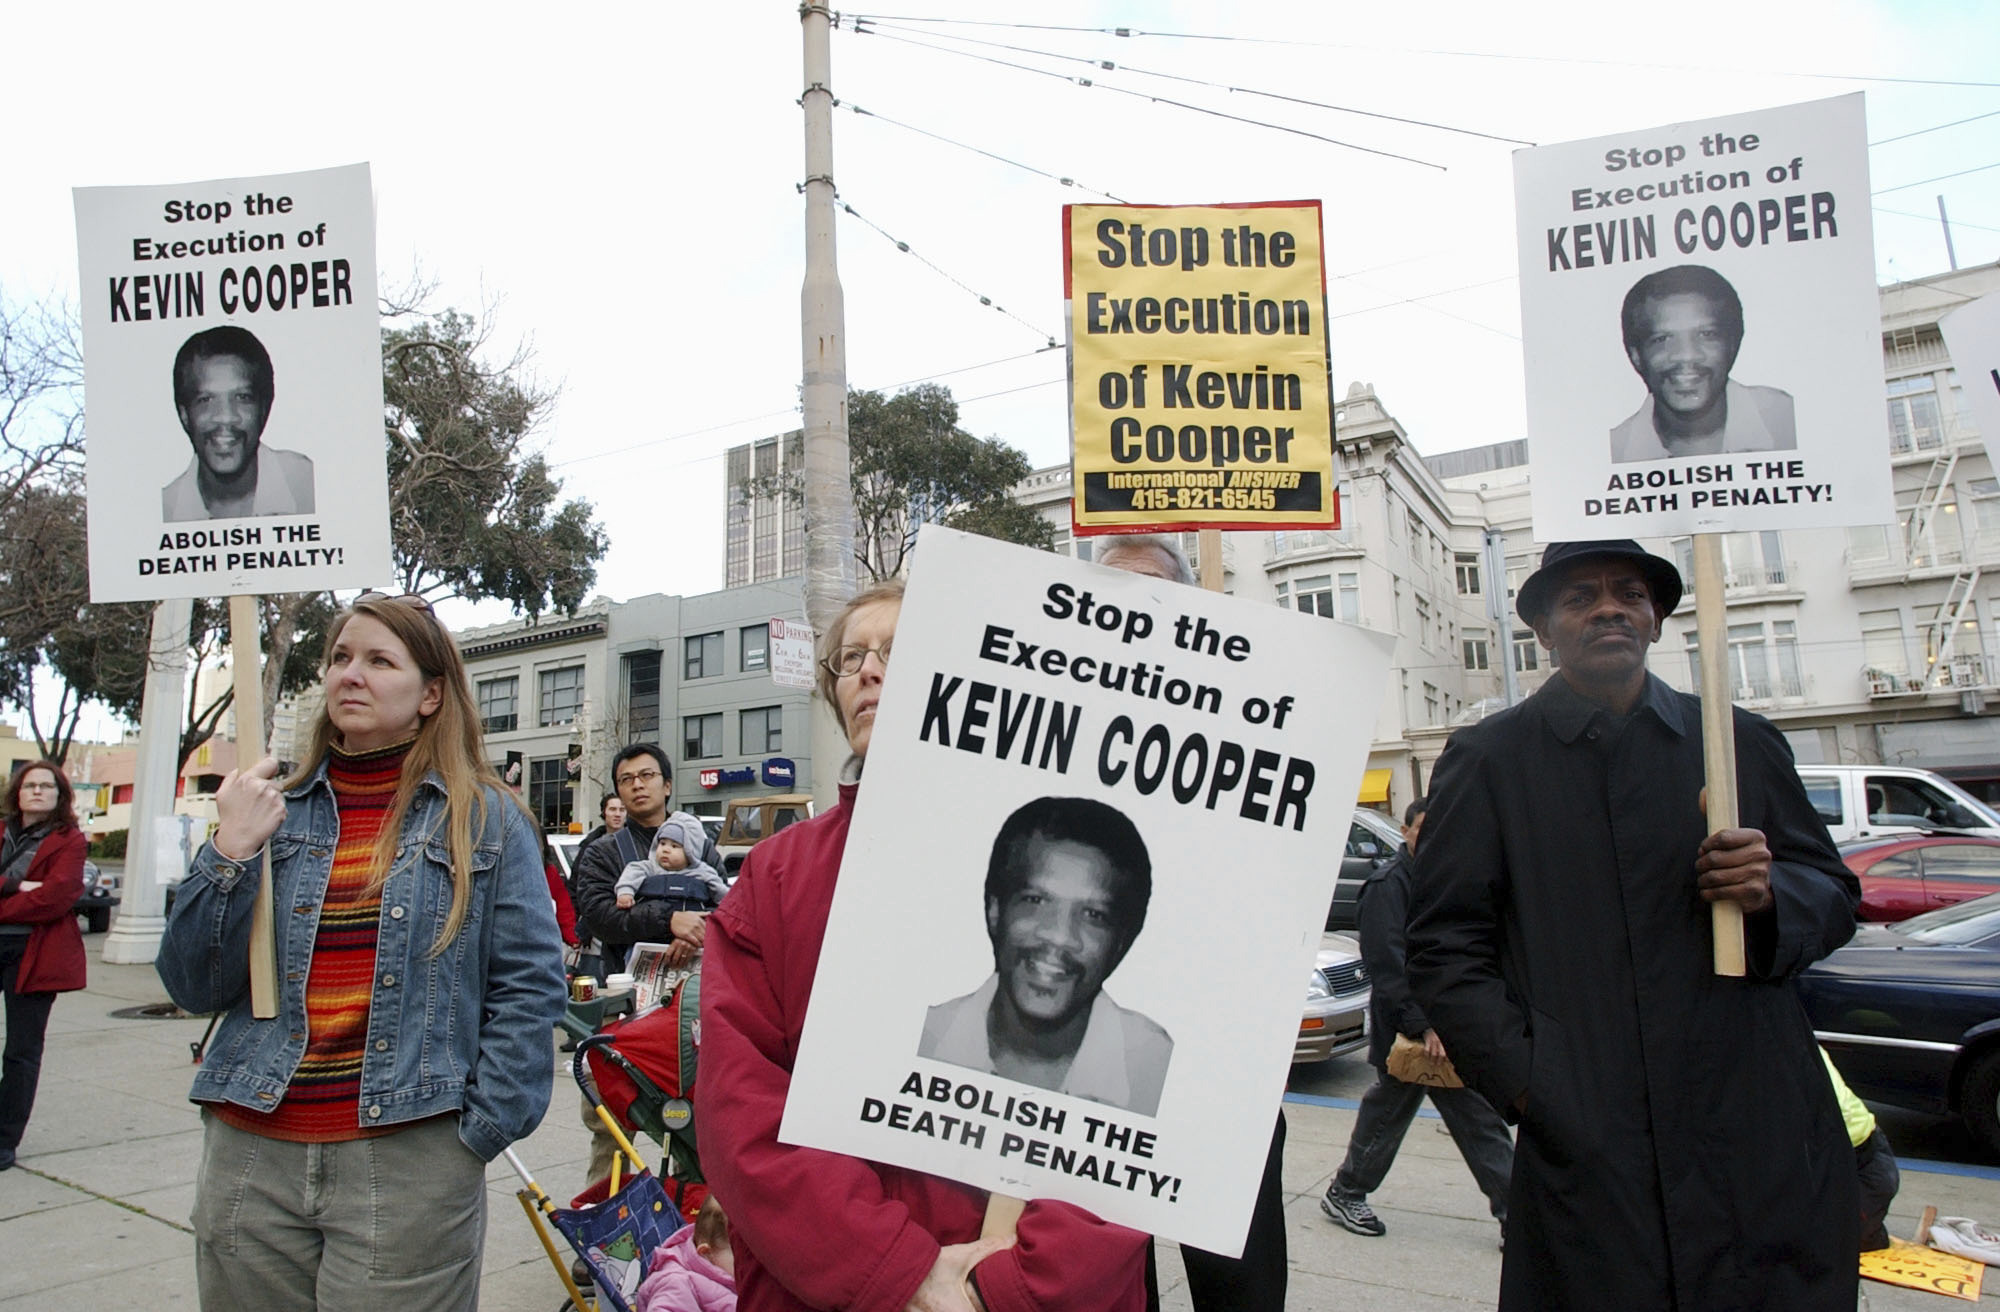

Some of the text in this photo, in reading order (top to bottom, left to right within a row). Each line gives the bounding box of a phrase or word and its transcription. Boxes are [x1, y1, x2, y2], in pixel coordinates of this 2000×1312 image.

[1606, 133, 1760, 172] Stop the
[1572, 156, 1803, 212] Execution of
[164, 192, 293, 224] Stop the
[133, 222, 326, 261] Execution of
[1096, 218, 1296, 272] Stop the
[1547, 191, 1838, 272] KEVIN COOPER
[109, 258, 353, 323] KEVIN COOPER
[1087, 292, 1310, 336] Execution
[1098, 364, 1302, 411] of Kevin
[1110, 416, 1294, 467] Cooper
[1107, 470, 1302, 489] International ANSWER
[1607, 460, 1805, 491] ABOLISH THE
[1131, 488, 1276, 510] 415-821-6545
[1584, 484, 1833, 516] DEATH PENALTY!
[159, 524, 321, 551] ABOLISH THE
[138, 547, 343, 576] DEATH PENALTY!
[772, 619, 812, 642] NO PARKING
[1042, 582, 1251, 662] Stop the
[979, 624, 1295, 730] Execution of
[919, 672, 1316, 832] KEVIN COOPER
[663, 1108, 688, 1119] Jeep
[899, 1070, 1157, 1159] ABOLISH THE
[860, 1097, 1182, 1203] DEATH PENALTY!
